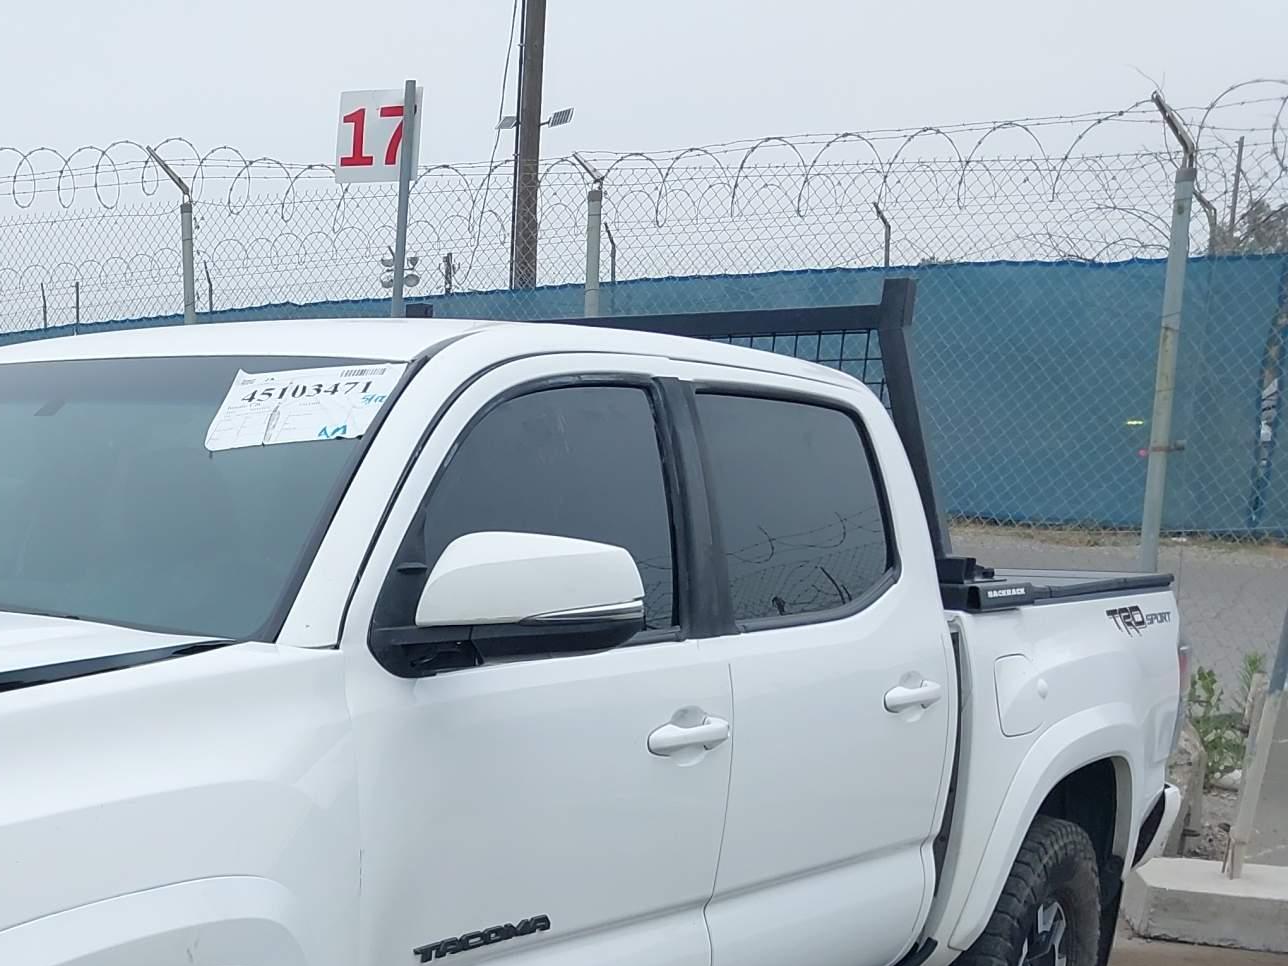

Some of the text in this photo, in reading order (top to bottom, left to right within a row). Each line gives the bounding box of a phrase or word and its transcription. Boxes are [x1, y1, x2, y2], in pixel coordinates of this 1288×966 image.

[339, 104, 417, 168] 17
[240, 380, 373, 403] 45103471
[1105, 605, 1171, 637] TRD SPORT
[413, 913, 551, 963] TACOMA
